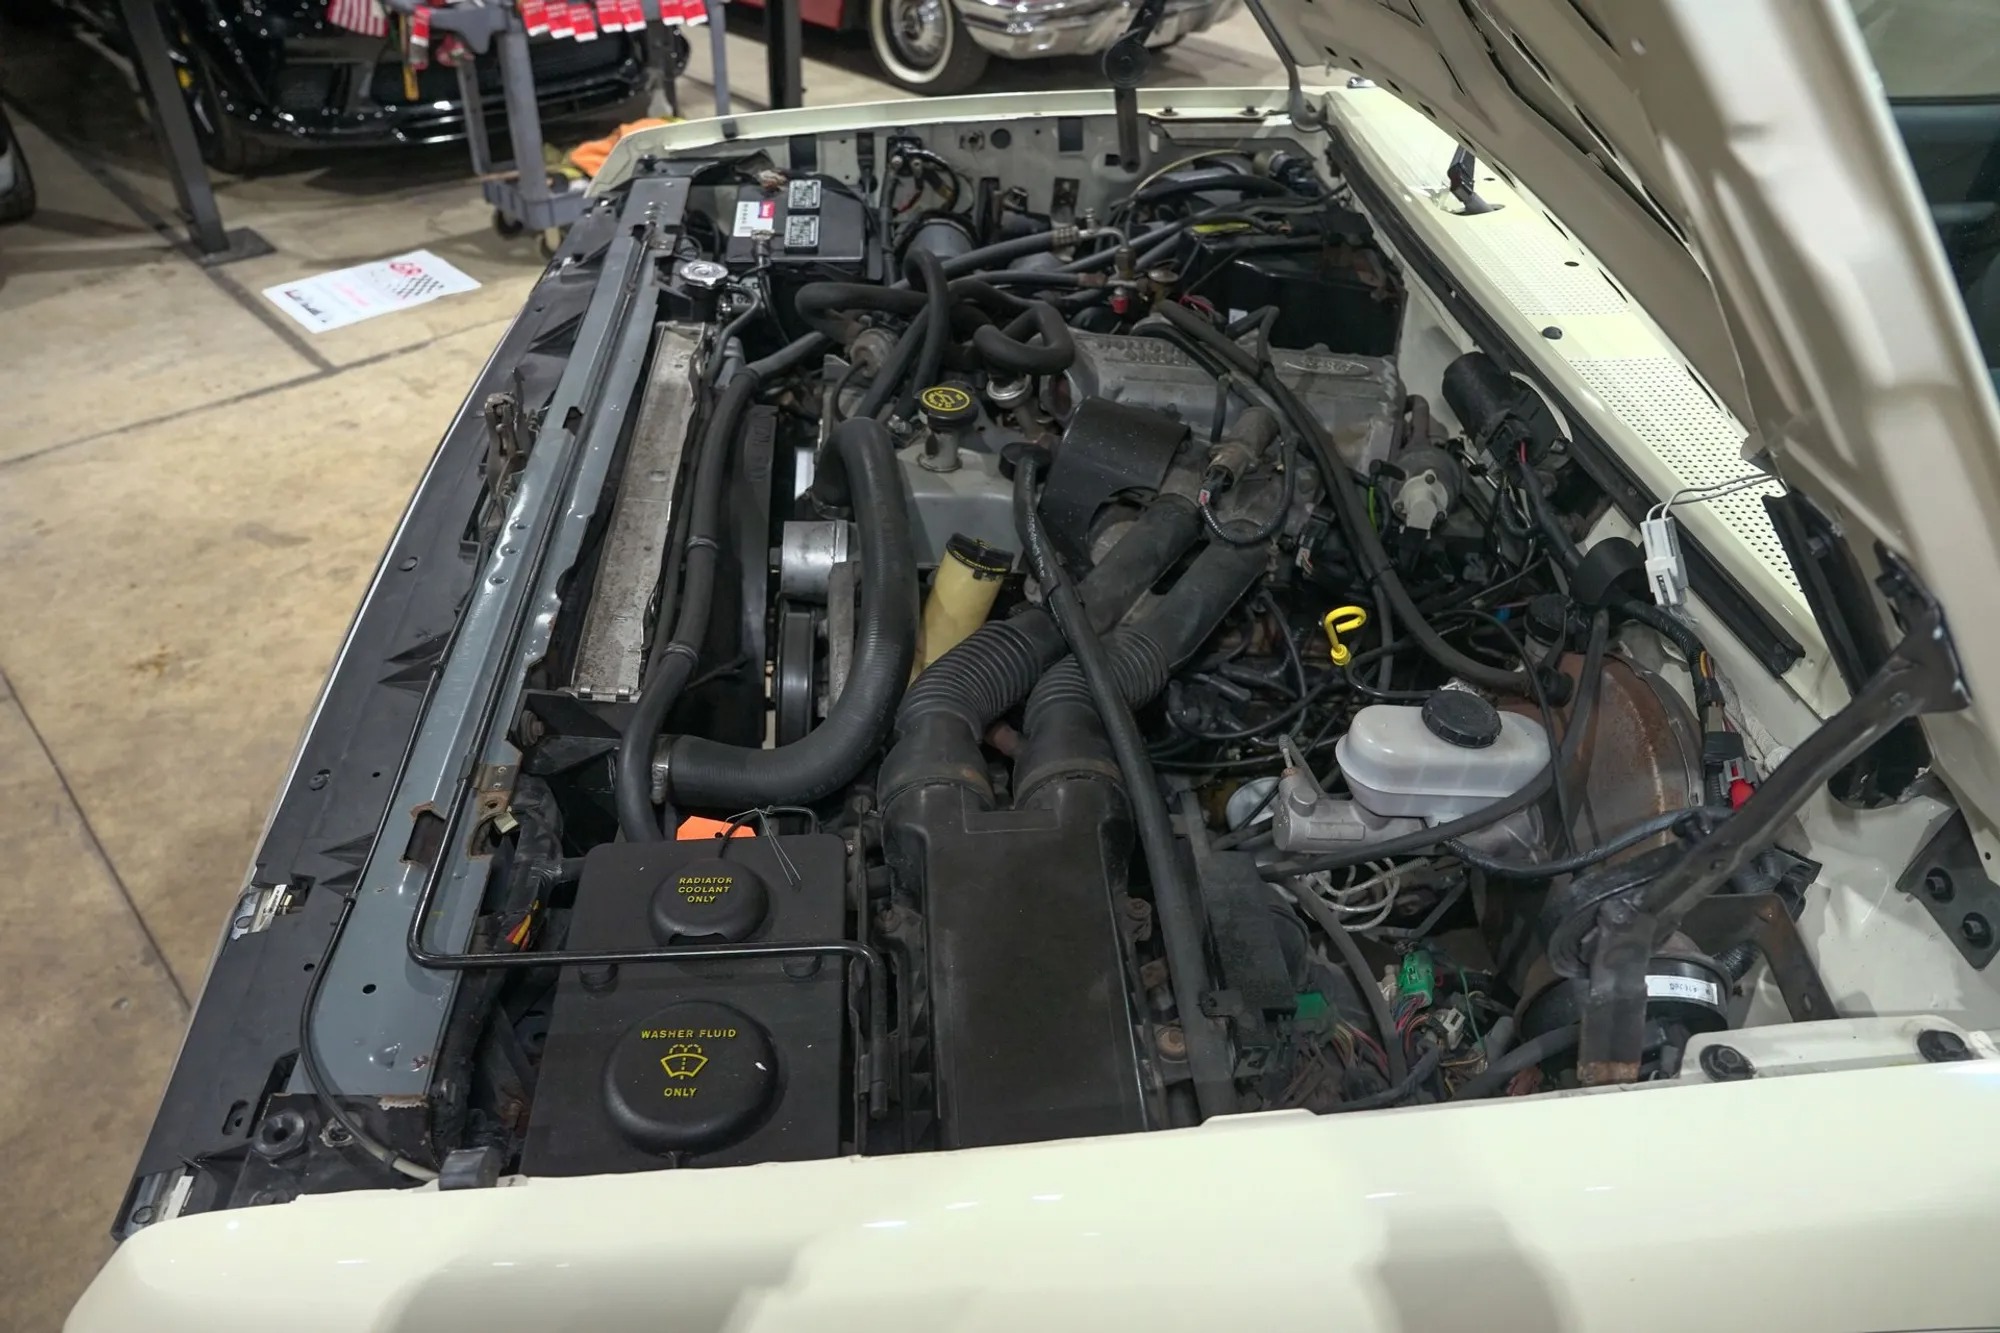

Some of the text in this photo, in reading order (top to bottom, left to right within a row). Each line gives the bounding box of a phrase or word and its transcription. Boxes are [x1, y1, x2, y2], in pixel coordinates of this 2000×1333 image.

[687, 895, 716, 903] ONLY
[641, 1027, 736, 1039] WASHER FLUID
[664, 1087, 697, 1098] ONLY
